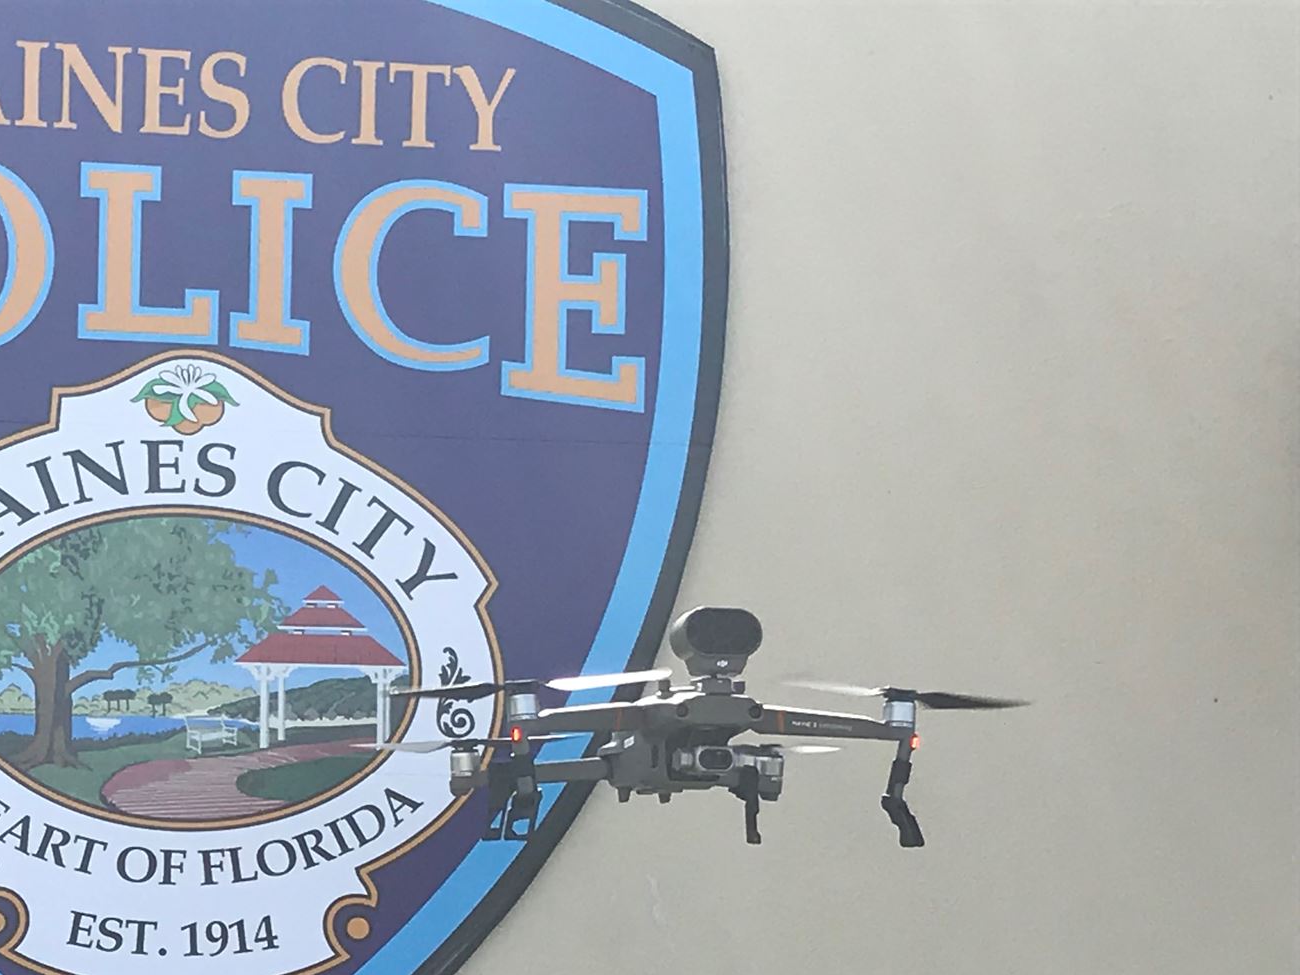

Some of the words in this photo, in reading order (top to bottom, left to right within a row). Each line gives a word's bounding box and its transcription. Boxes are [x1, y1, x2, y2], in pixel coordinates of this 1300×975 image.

[282, 58, 516, 151] CITY
[267, 461, 458, 600] CITY
[117, 847, 187, 885] OF
[199, 788, 424, 886] FLORIDA
[67, 911, 168, 957] EST.
[181, 915, 279, 957] 1914
